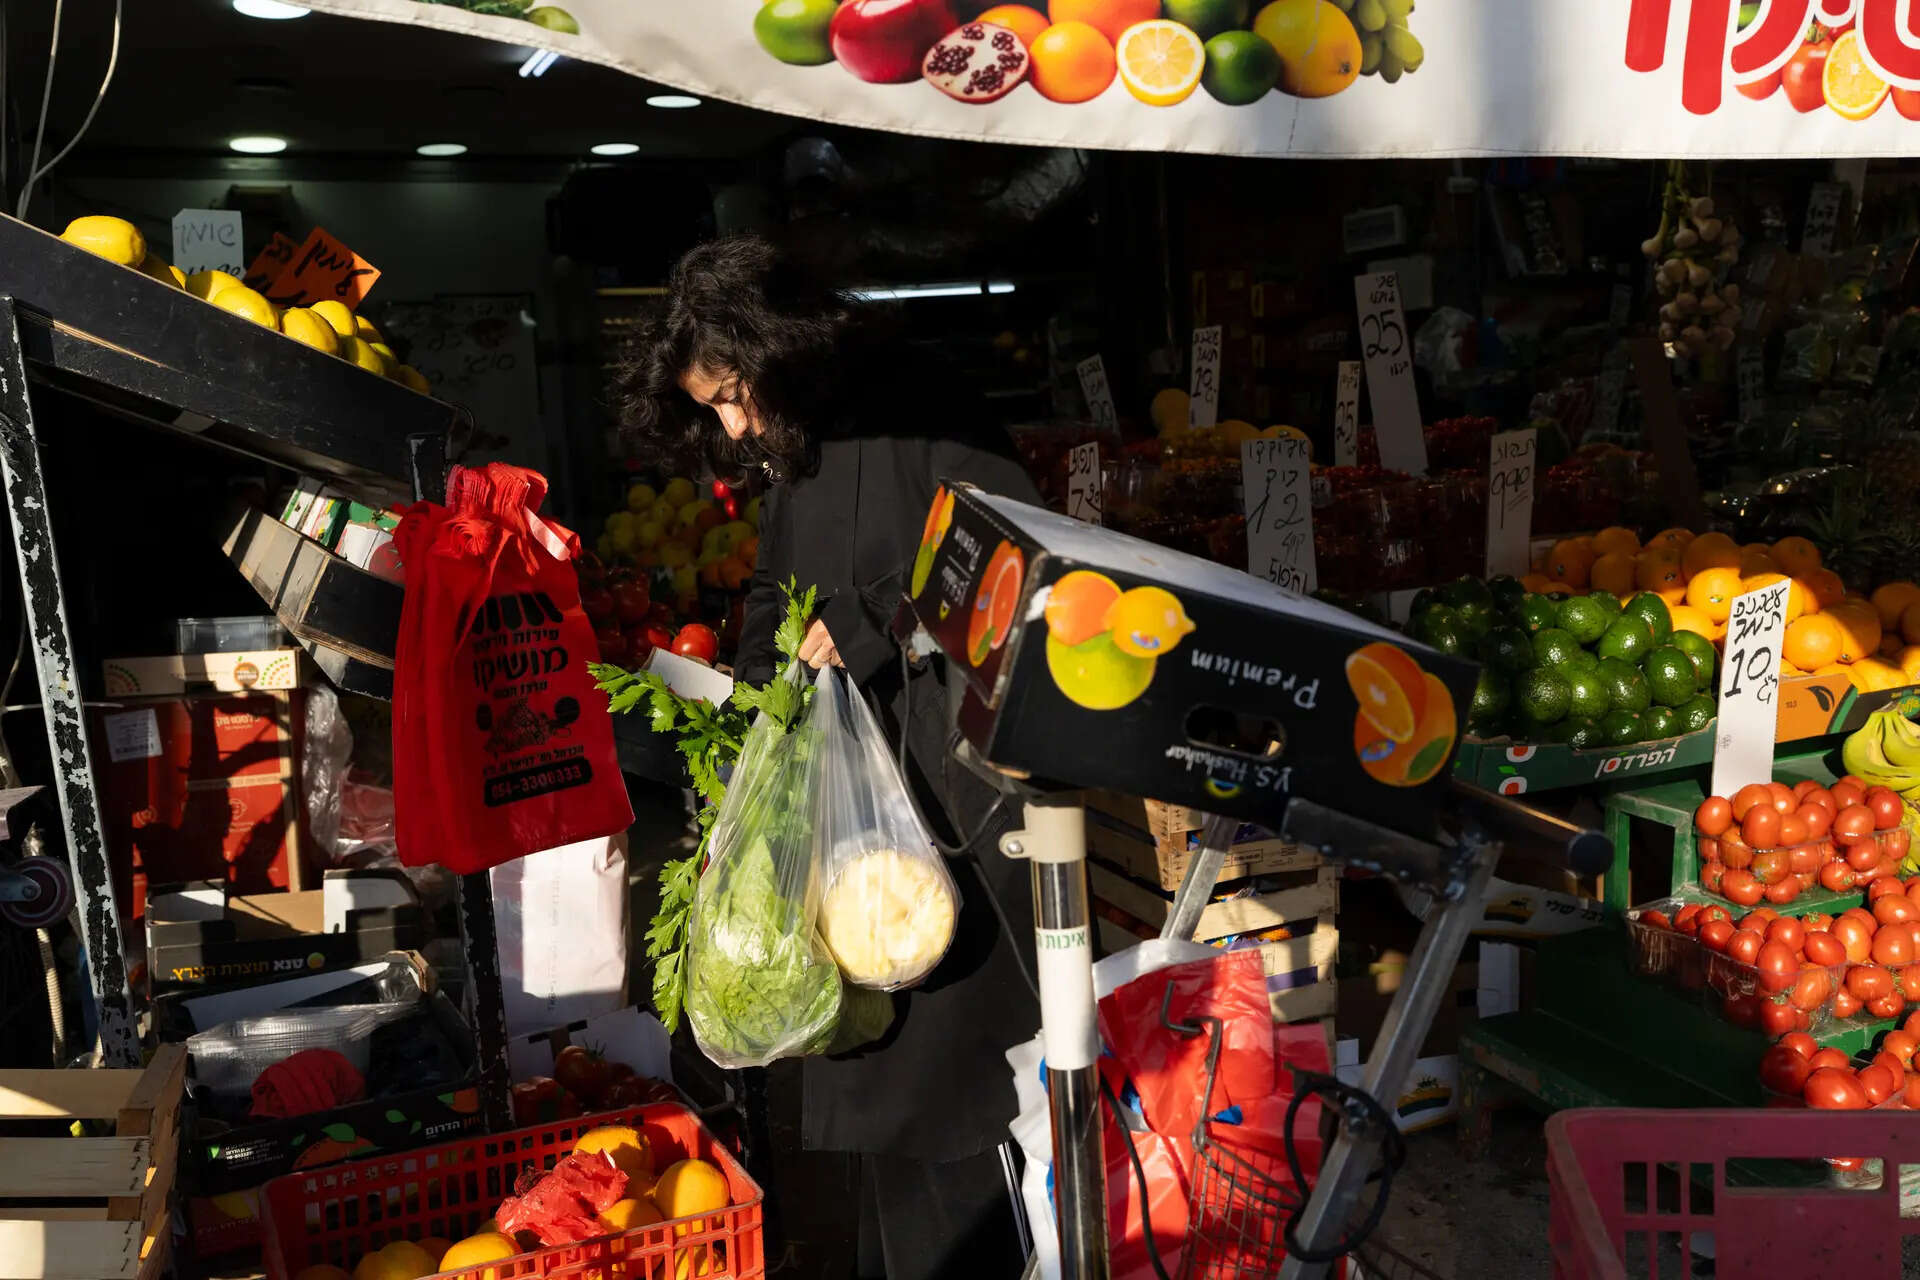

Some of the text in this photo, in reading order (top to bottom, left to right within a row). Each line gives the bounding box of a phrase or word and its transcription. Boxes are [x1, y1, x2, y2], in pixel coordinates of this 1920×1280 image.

[1362, 309, 1404, 359] 25
[512, 629, 560, 647] פירות
[1190, 648, 1320, 710] Premium
[1723, 647, 1772, 699] 10
[1594, 747, 1677, 779] הפרדסן
[1046, 930, 1086, 950] איכות
[273, 957, 305, 973] טנא
[424, 1120, 461, 1137] הדרום
